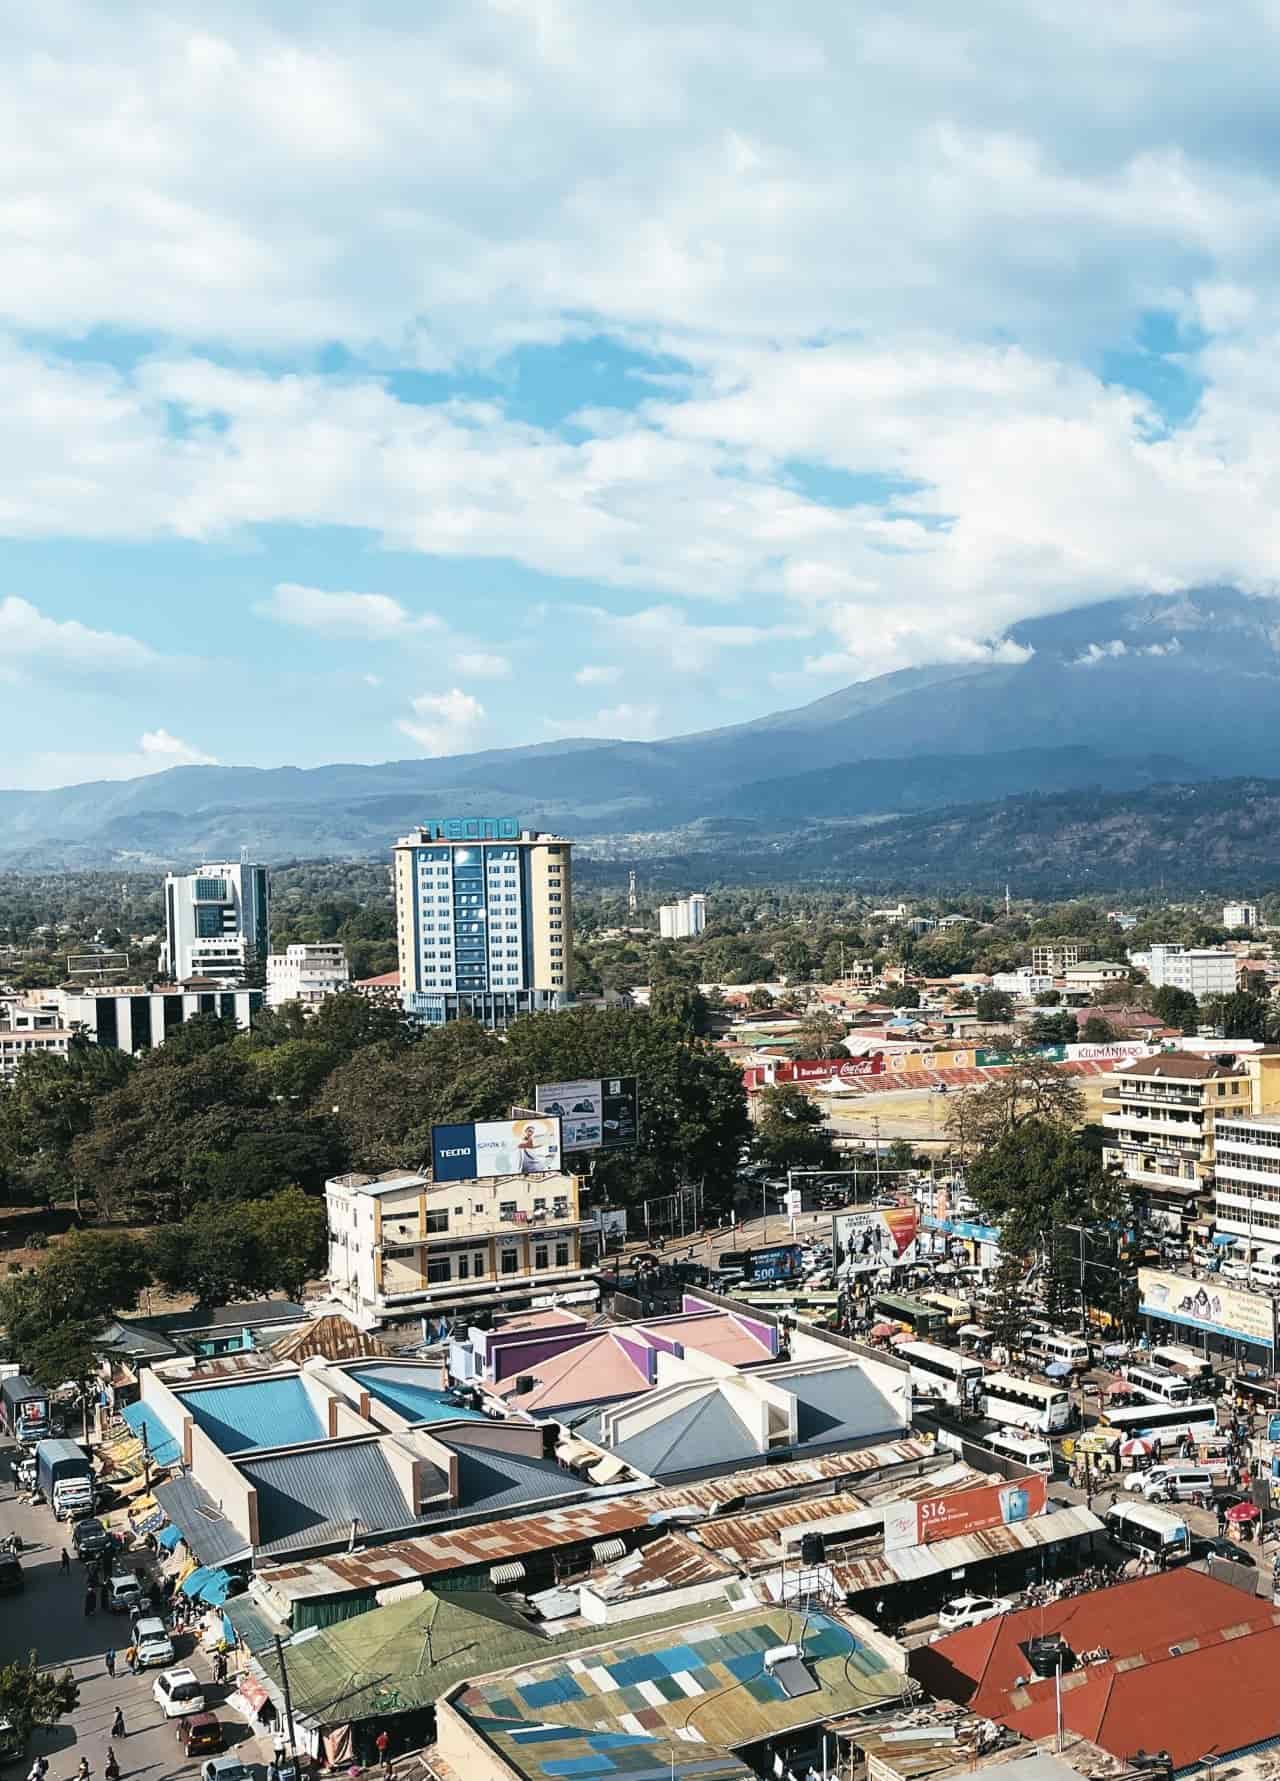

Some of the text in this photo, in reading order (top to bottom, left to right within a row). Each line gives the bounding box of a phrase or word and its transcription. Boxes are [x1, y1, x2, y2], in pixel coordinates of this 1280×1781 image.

[423, 817, 520, 840] TECNO
[1078, 1046, 1143, 1059] KILIMANJARO
[840, 1061, 874, 1076] Coca-Cola
[440, 1147, 471, 1158] TECNO
[754, 1268, 775, 1281] 500
[921, 1501, 946, 1519] S16
